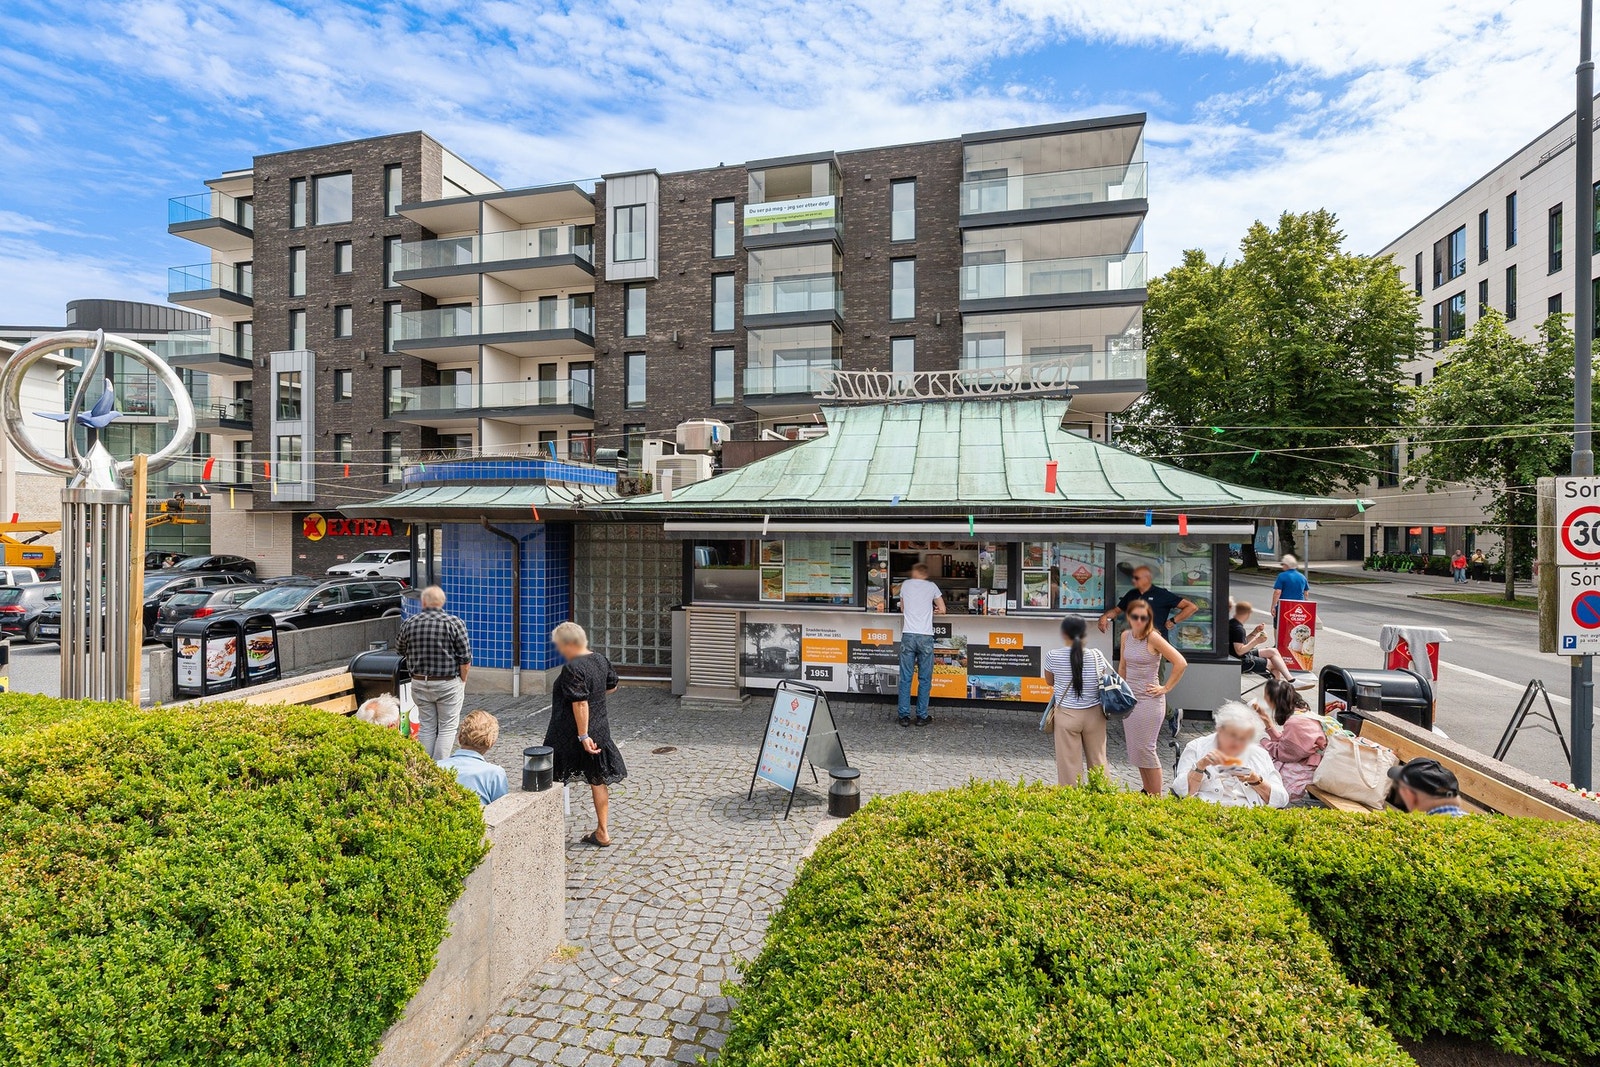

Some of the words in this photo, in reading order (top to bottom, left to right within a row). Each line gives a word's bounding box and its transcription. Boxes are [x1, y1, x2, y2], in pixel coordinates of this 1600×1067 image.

[327, 518, 393, 537] EXTRA
[932, 627, 947, 635] 983
[1566, 637, 1574, 648] P
